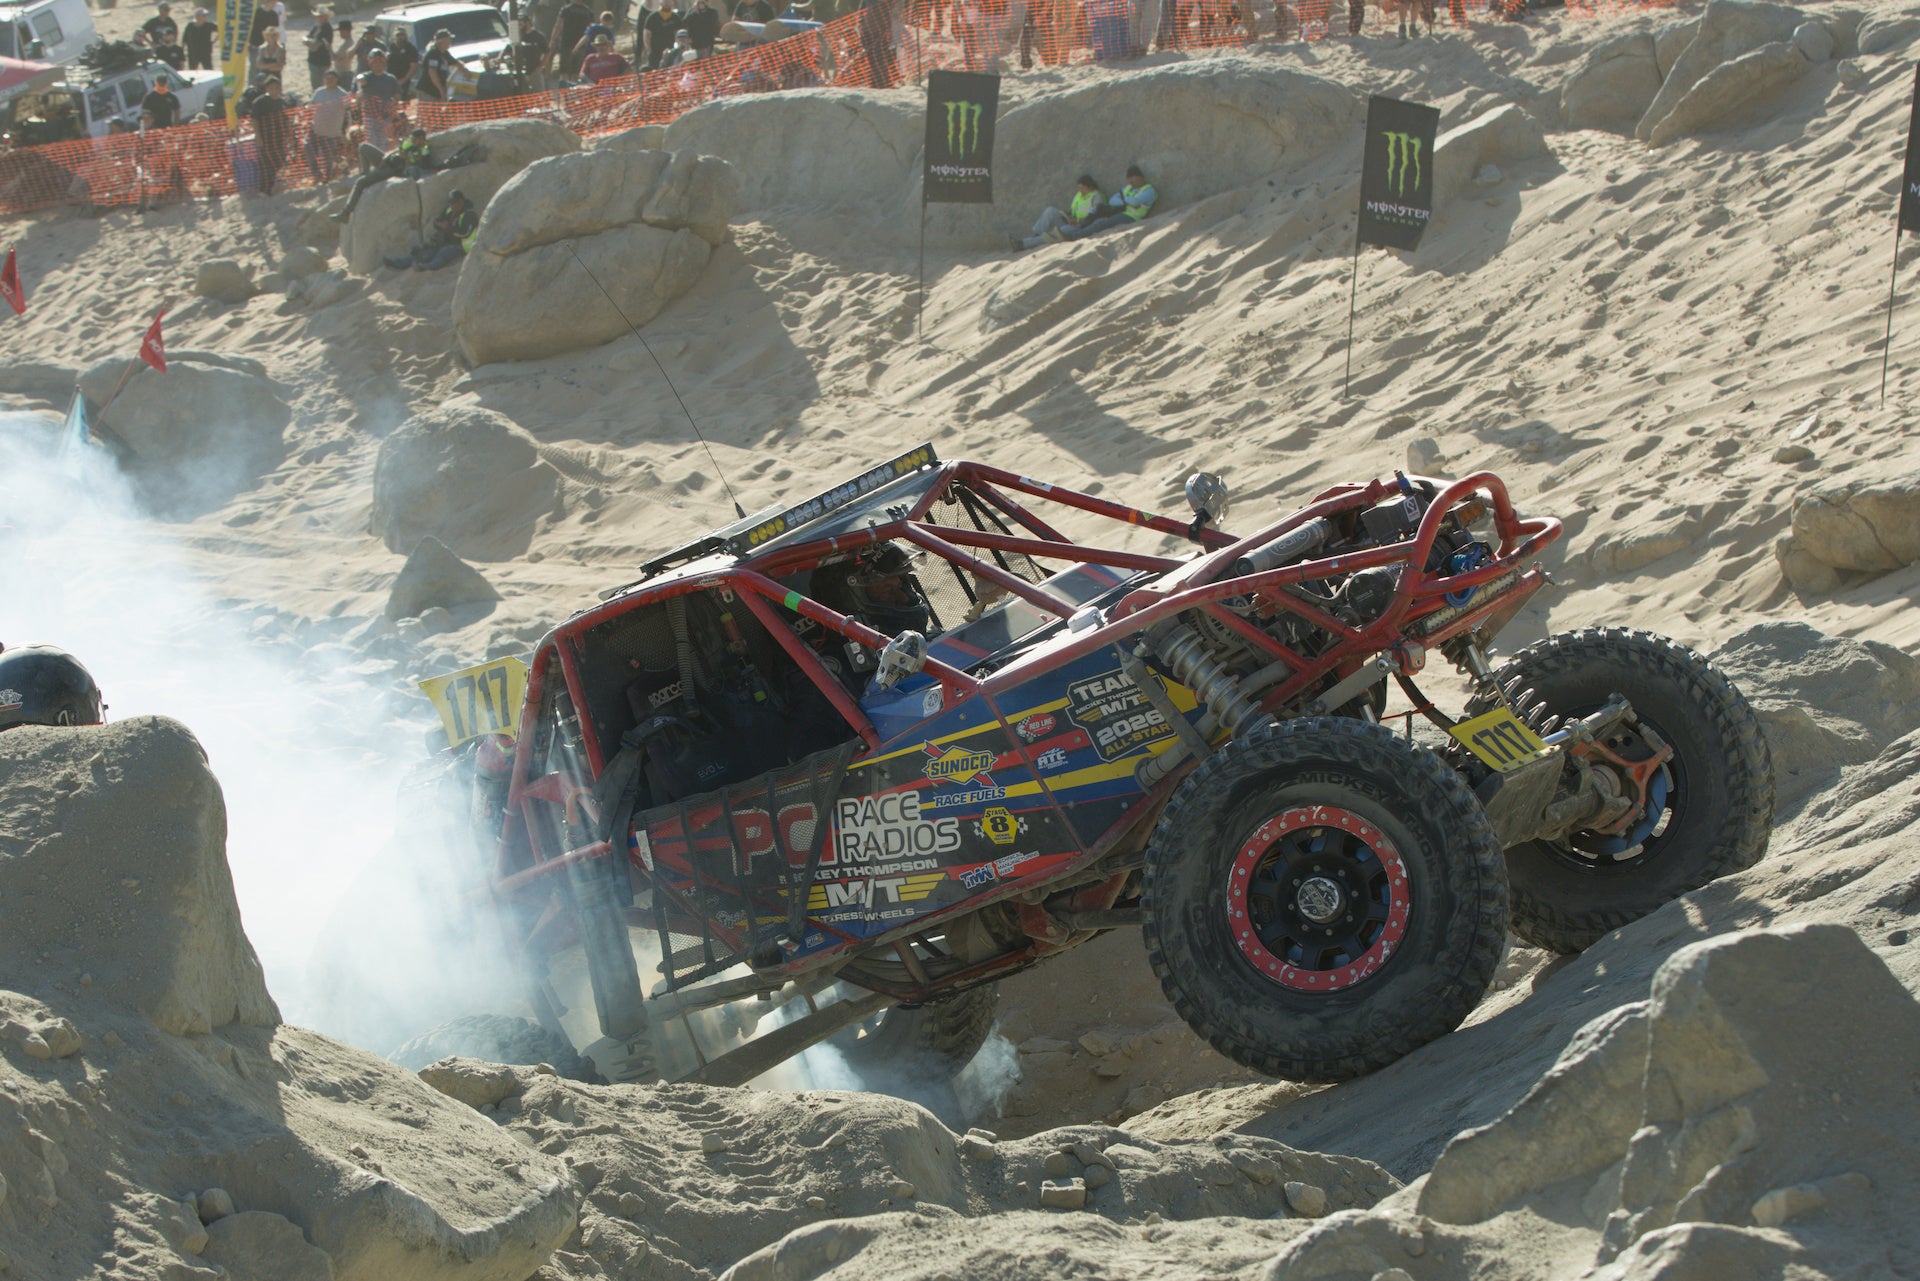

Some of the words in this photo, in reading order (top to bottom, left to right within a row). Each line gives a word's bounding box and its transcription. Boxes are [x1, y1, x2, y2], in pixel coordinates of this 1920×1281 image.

[930, 164, 990, 177] MONSTER
[1366, 200, 1430, 220] MONSTER
[446, 666, 511, 740] 1717
[1099, 692, 1140, 717] M/T
[1096, 709, 1165, 747] 2026
[1105, 723, 1172, 757] ALL-STAR
[1471, 720, 1538, 765] 1717
[930, 754, 989, 776] SUNOCO
[934, 793, 968, 807] RACE
[969, 787, 1006, 803] FUELS
[1299, 772, 1391, 801] MICKEY
[839, 791, 921, 830] RACE
[989, 816, 1010, 832] 8
[841, 819, 961, 861] RADIOS
[842, 858, 938, 879] THOMPSON
[824, 875, 907, 910] M/T
[863, 907, 916, 922] WHEELS
